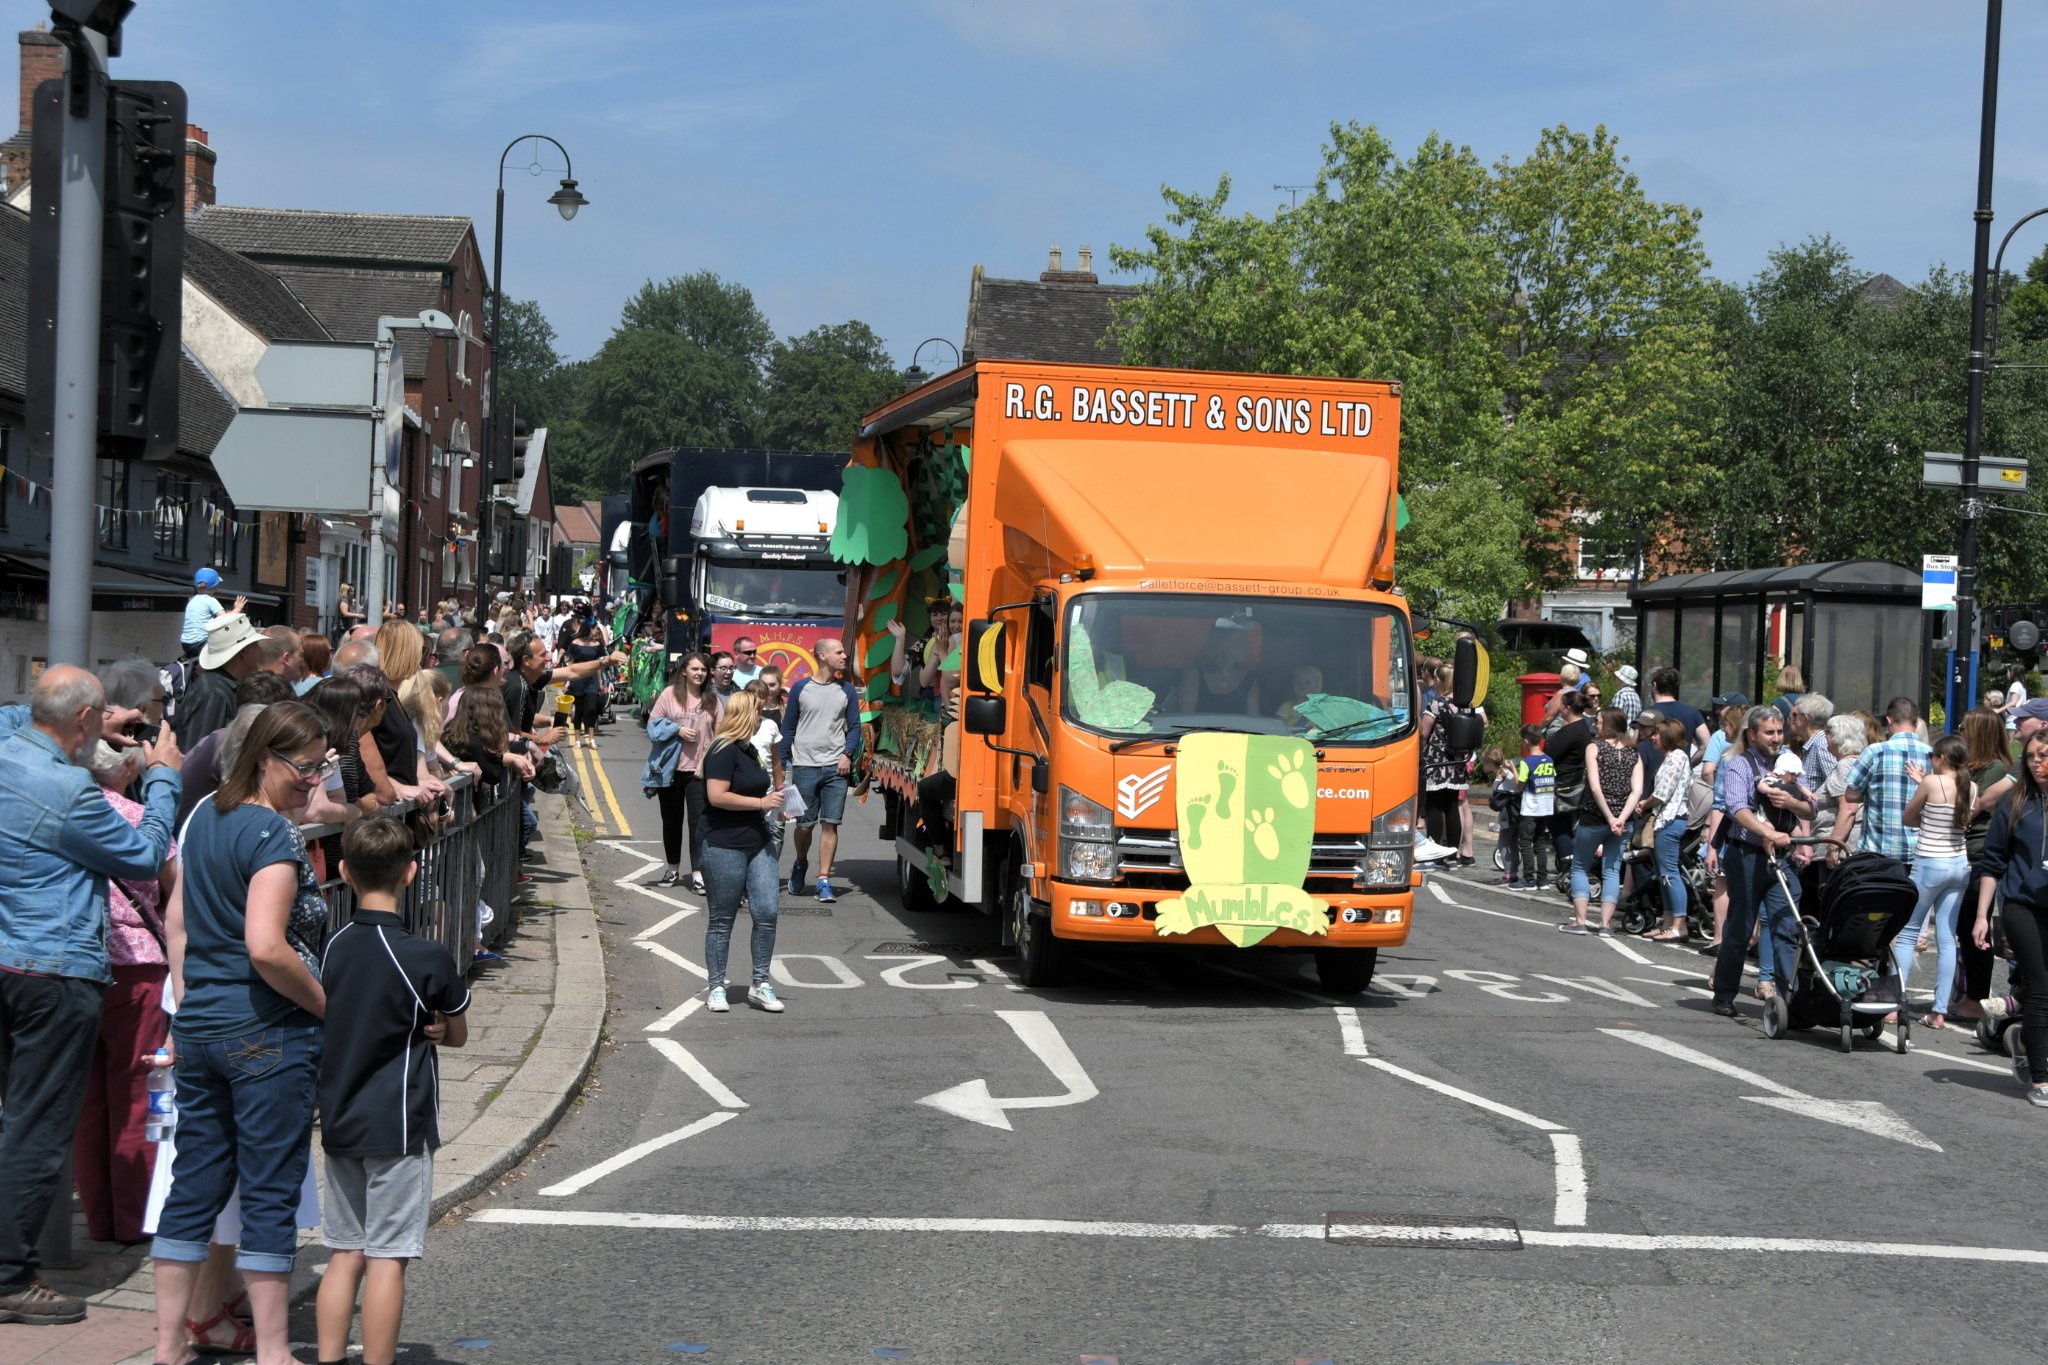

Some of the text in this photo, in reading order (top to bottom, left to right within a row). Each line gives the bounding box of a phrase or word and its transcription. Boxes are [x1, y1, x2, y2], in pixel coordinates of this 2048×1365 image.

[1005, 383, 1373, 437] R.G. BASSETT & SONS LTD
[1140, 579, 1340, 597] palletforce@bassett-group.co.uk
[1533, 762, 1554, 776] 46
[1316, 787, 1370, 799] ce.com
